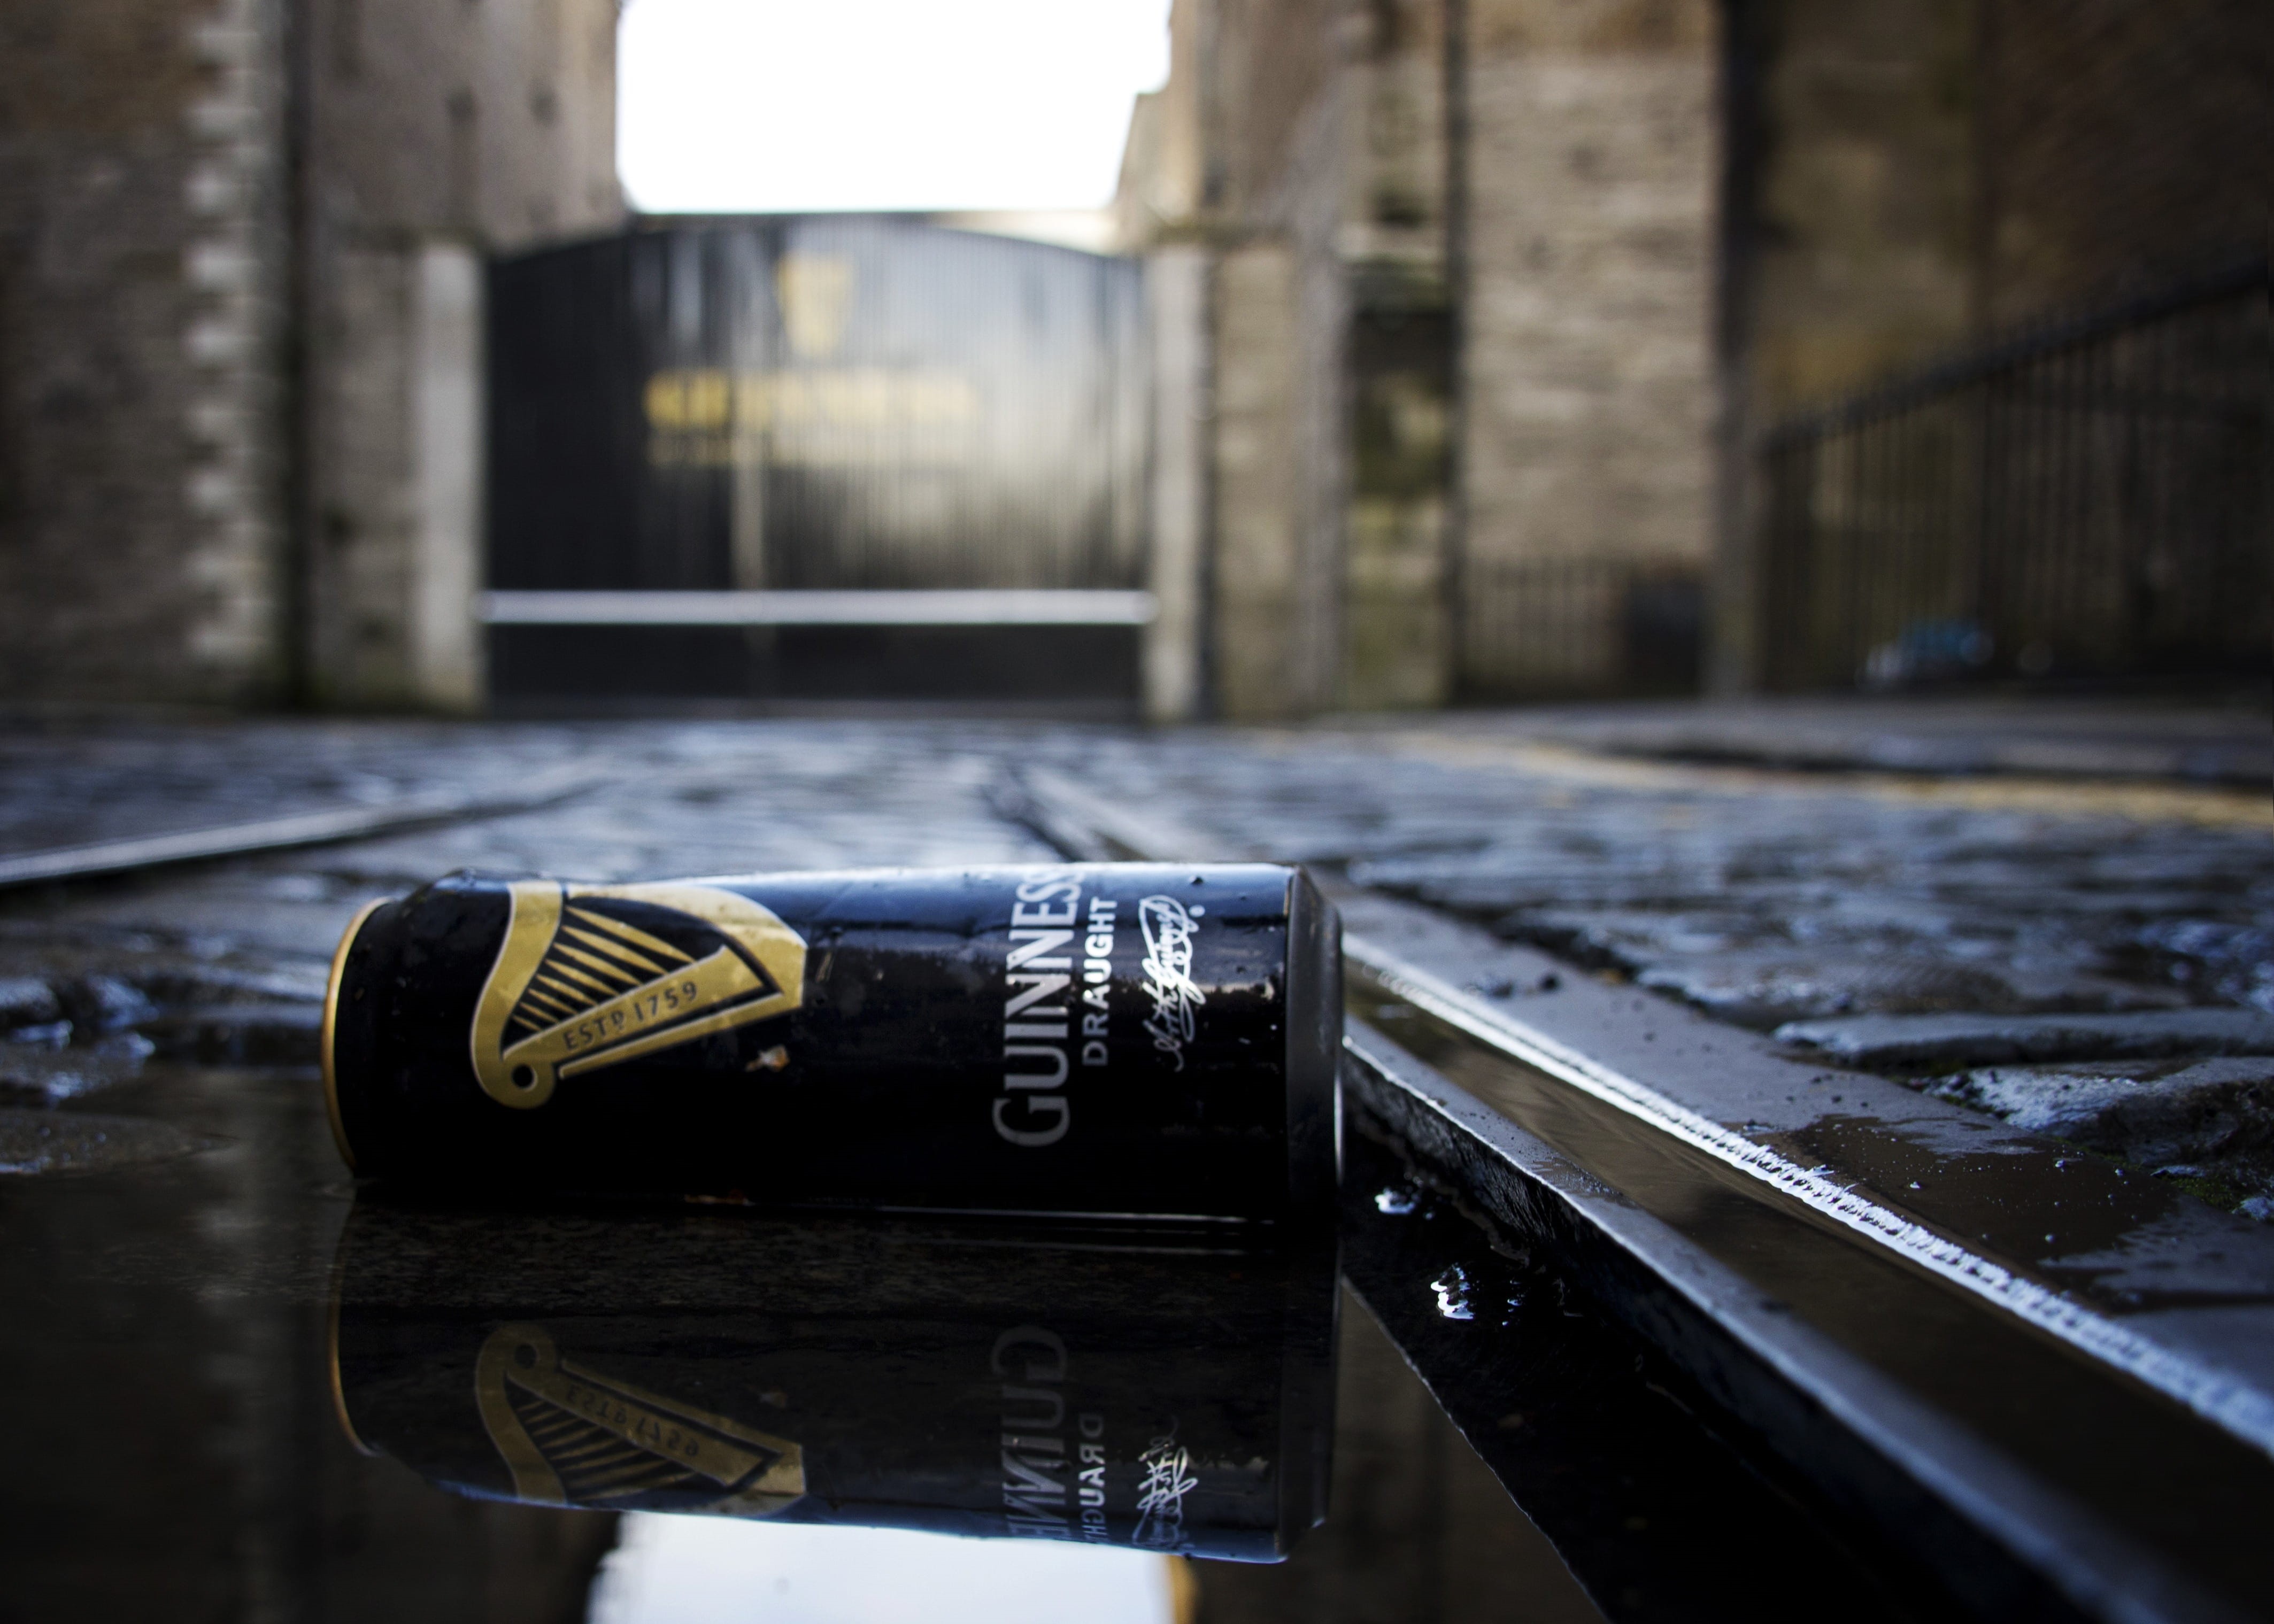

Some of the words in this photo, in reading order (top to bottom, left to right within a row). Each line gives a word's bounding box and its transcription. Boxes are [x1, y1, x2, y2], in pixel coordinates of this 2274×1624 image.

[634, 982, 697, 1022] 1759
[992, 866, 1085, 1147] GUINNESS
[1082, 898, 1118, 1066] DRAUGHT
